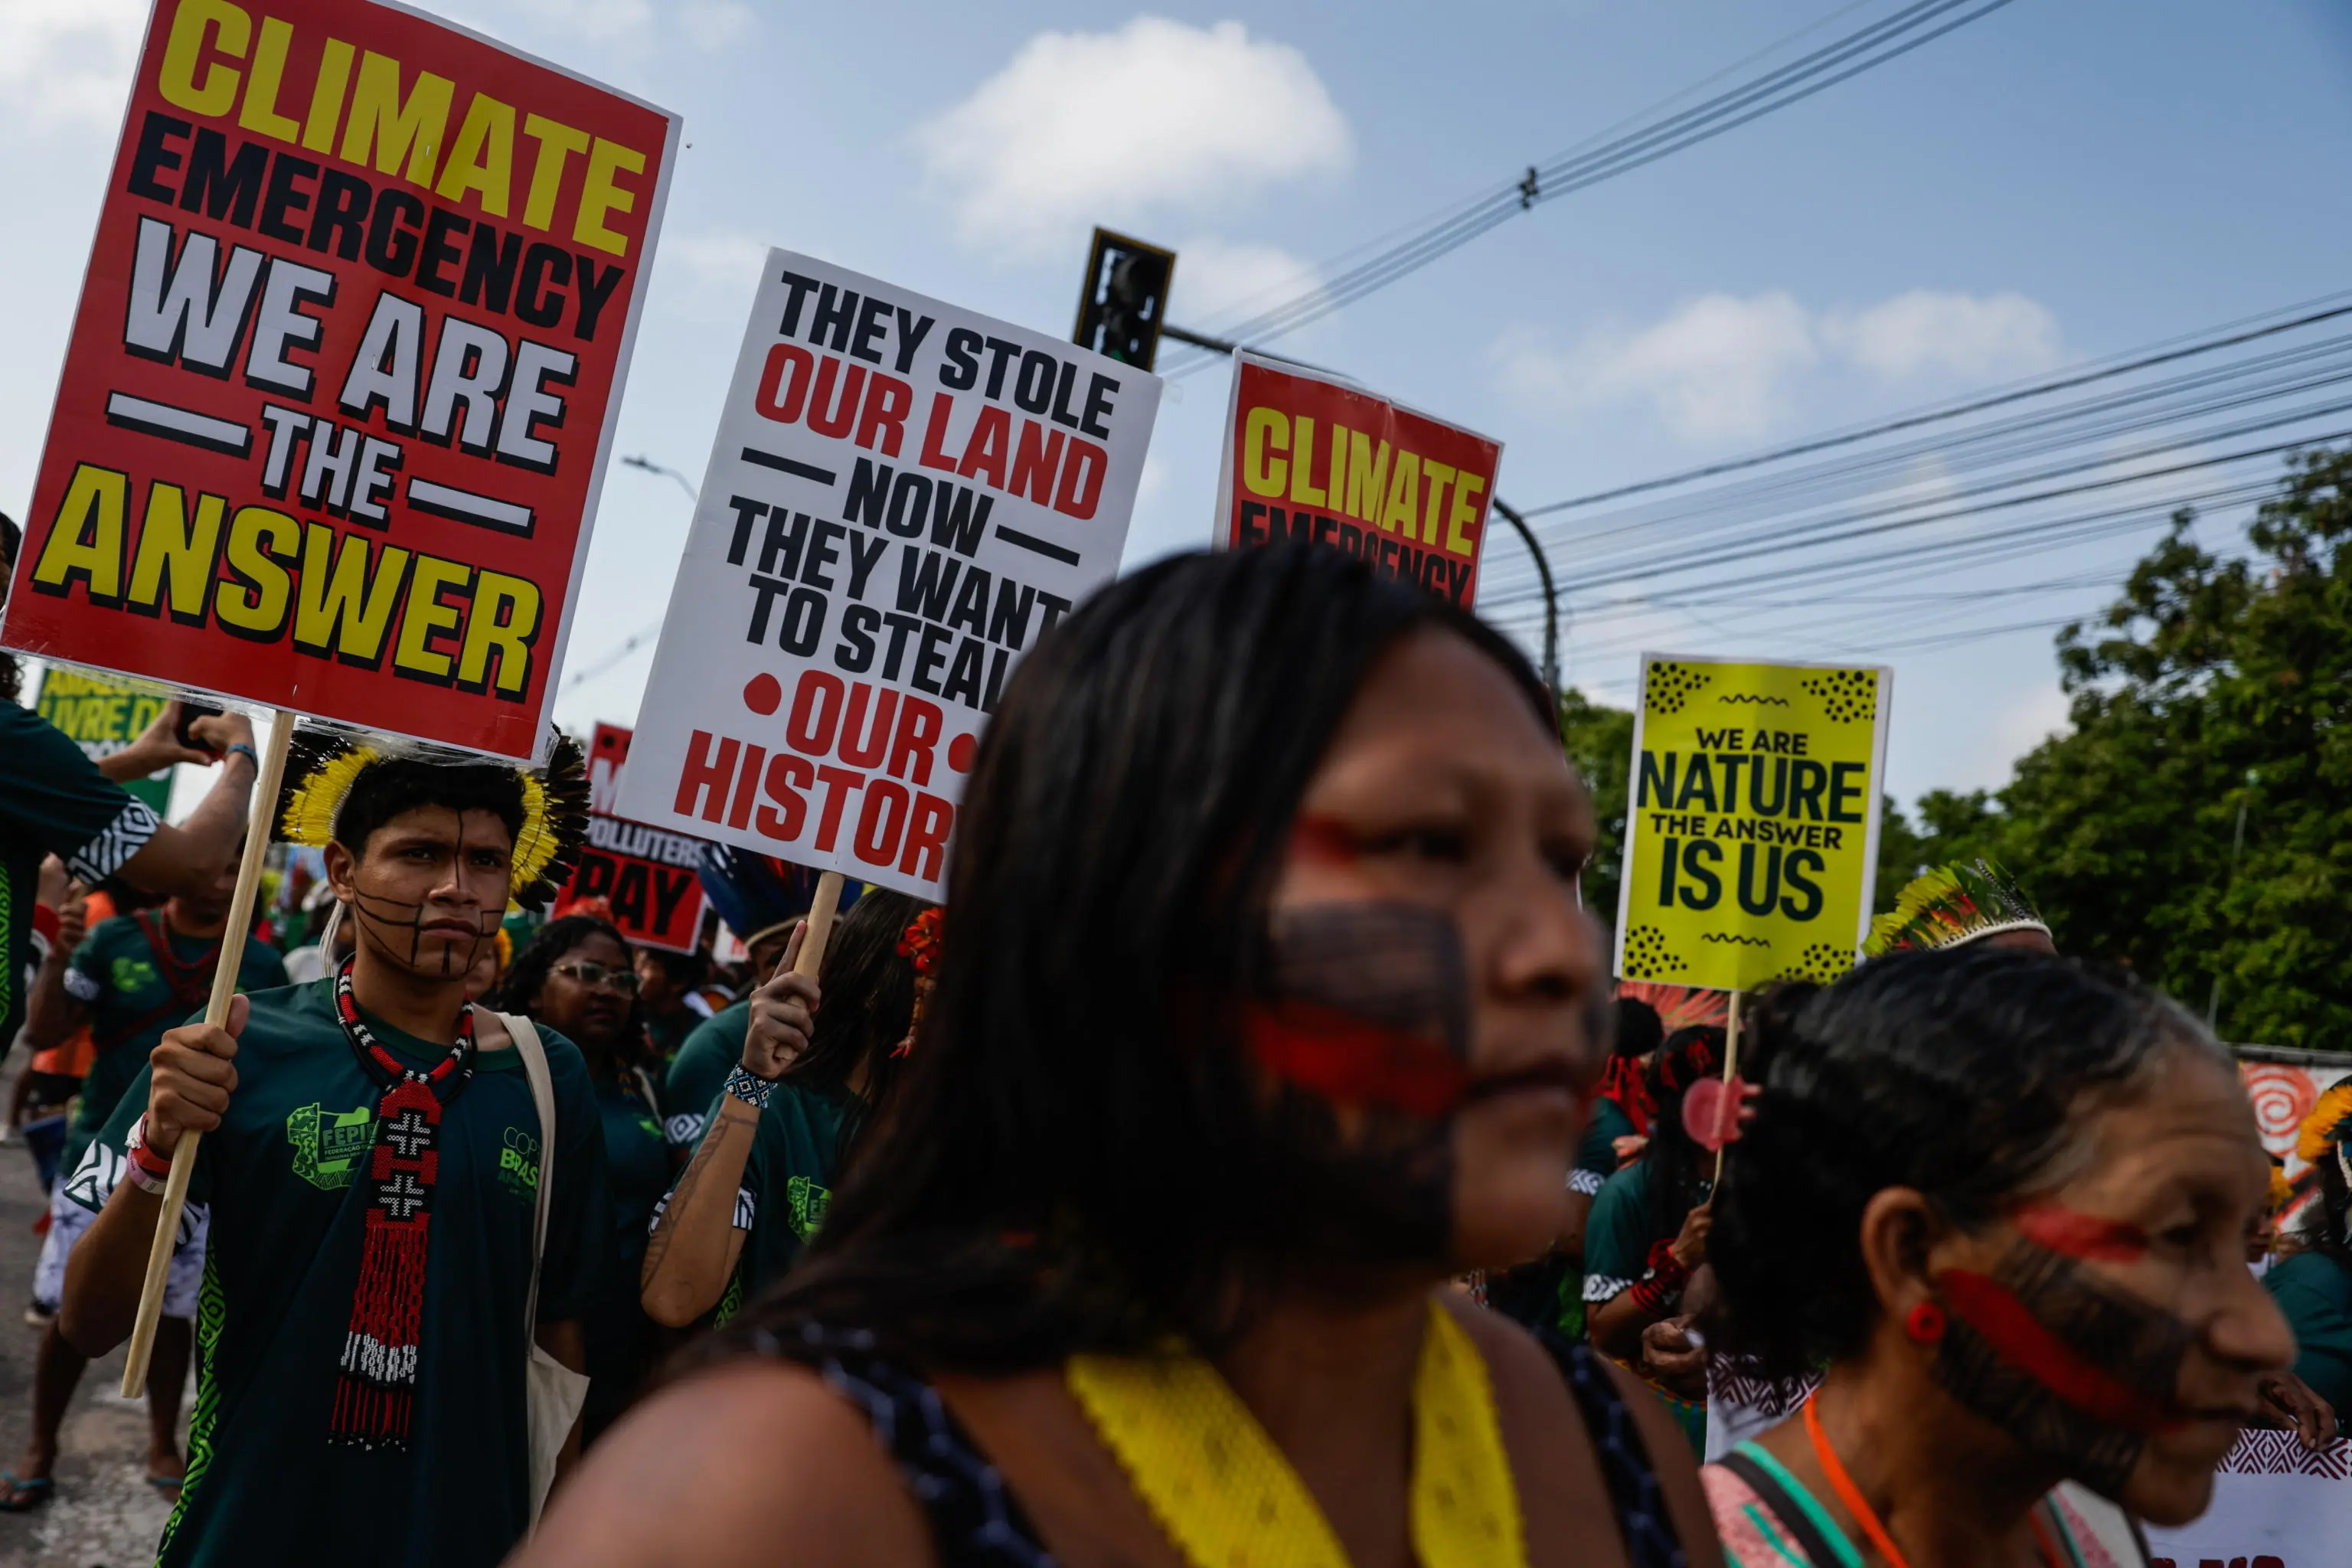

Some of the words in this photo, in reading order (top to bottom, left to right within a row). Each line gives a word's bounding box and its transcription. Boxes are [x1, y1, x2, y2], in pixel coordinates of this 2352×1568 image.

[158, 0, 647, 257] CLIMATE
[126, 109, 625, 341] EMERGENCY
[124, 215, 336, 399] WE
[339, 291, 579, 474] ARE
[779, 271, 935, 375] THEY
[939, 328, 1120, 441] STOLE
[261, 402, 404, 529] THE
[755, 343, 913, 458] OUR
[919, 392, 1109, 521] LAND
[1243, 407, 1485, 557] CLIMATE
[843, 457, 995, 558] NOW
[31, 462, 544, 701] ANSWER
[727, 495, 889, 598] THEY
[896, 544, 1072, 652] WANT
[746, 573, 828, 658] TO
[785, 669, 944, 787] OUR
[1637, 750, 1865, 824] NATURE
[1696, 727, 1743, 750] WE
[1751, 730, 1808, 756] ARE
[587, 816, 704, 868] OLLUTERS
[673, 729, 962, 884] HISTOR
[1651, 813, 1707, 836] THE
[1713, 818, 1842, 851] ANSWER
[575, 854, 693, 936] PAY
[1658, 838, 1723, 911] IS
[1737, 843, 1825, 922] US
